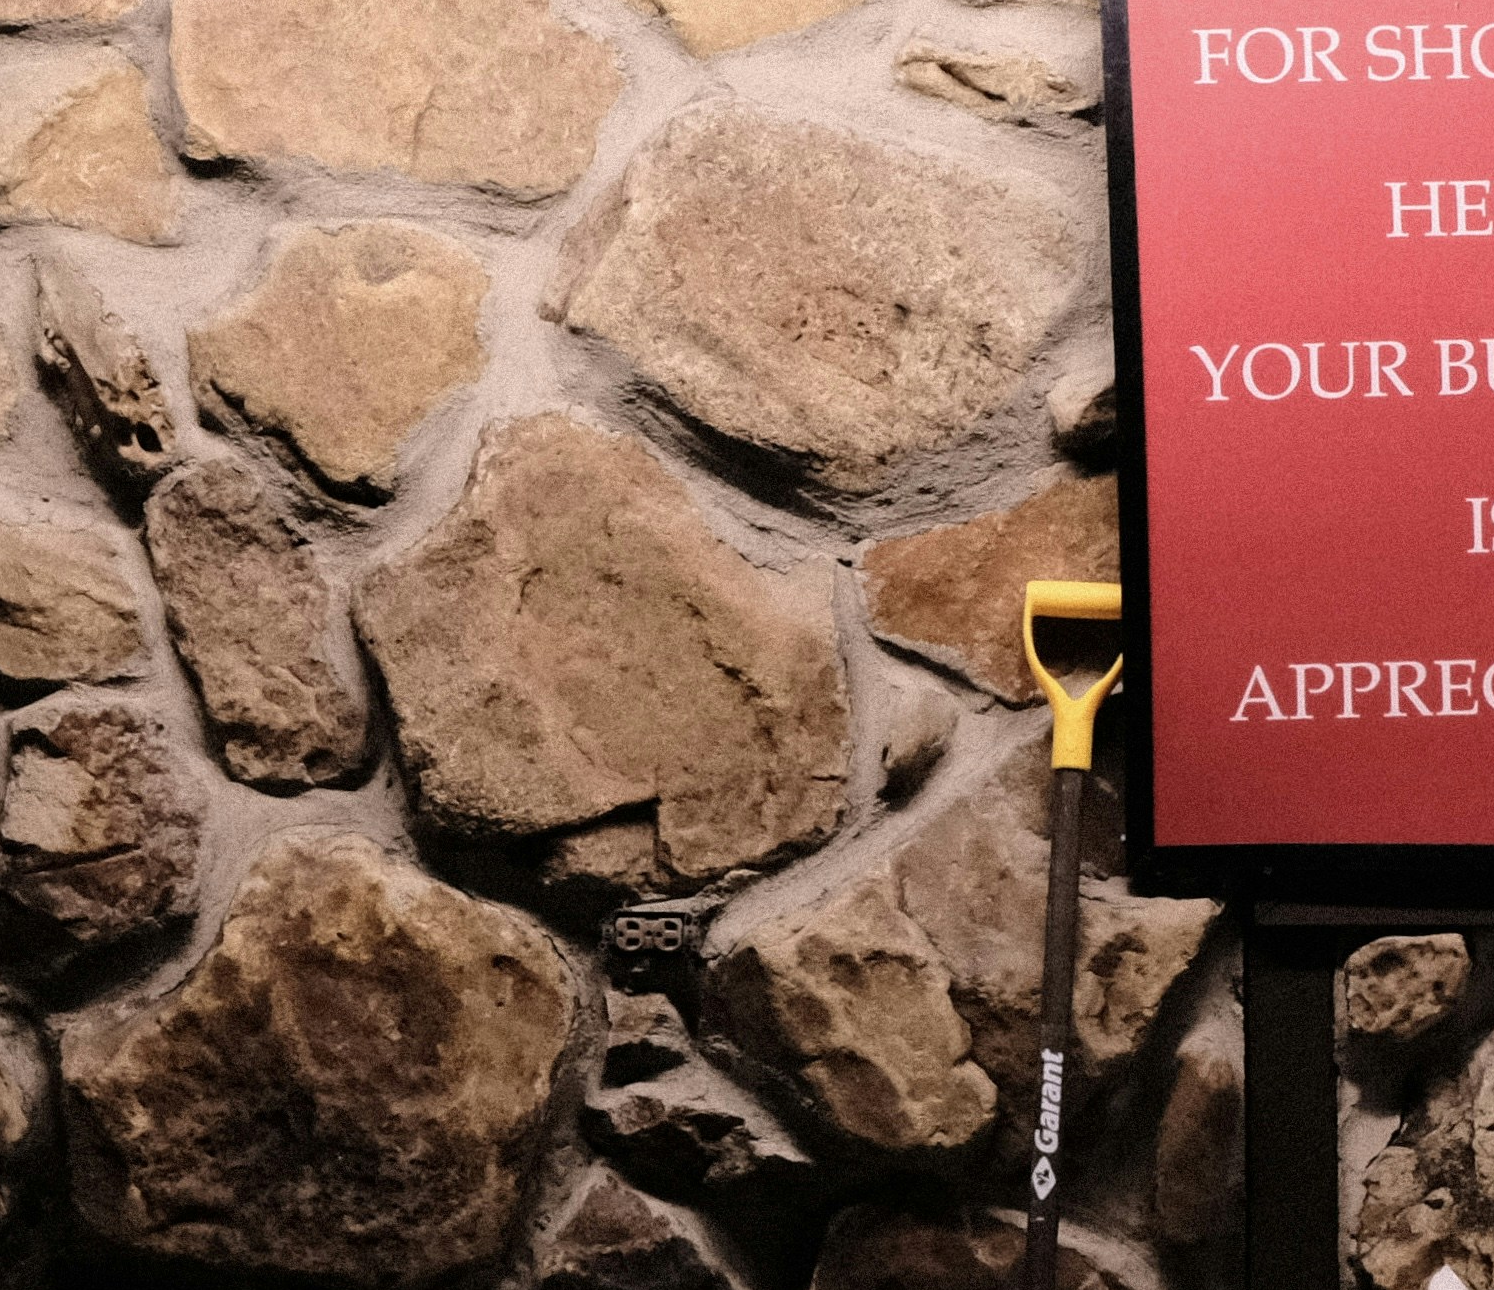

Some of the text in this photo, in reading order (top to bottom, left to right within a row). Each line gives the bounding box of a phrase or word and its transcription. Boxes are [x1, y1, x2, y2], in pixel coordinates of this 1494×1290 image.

[1193, 27, 1348, 85] FOR
[1189, 341, 1415, 402] YOUR
[1034, 1048, 1064, 1153] Garant
